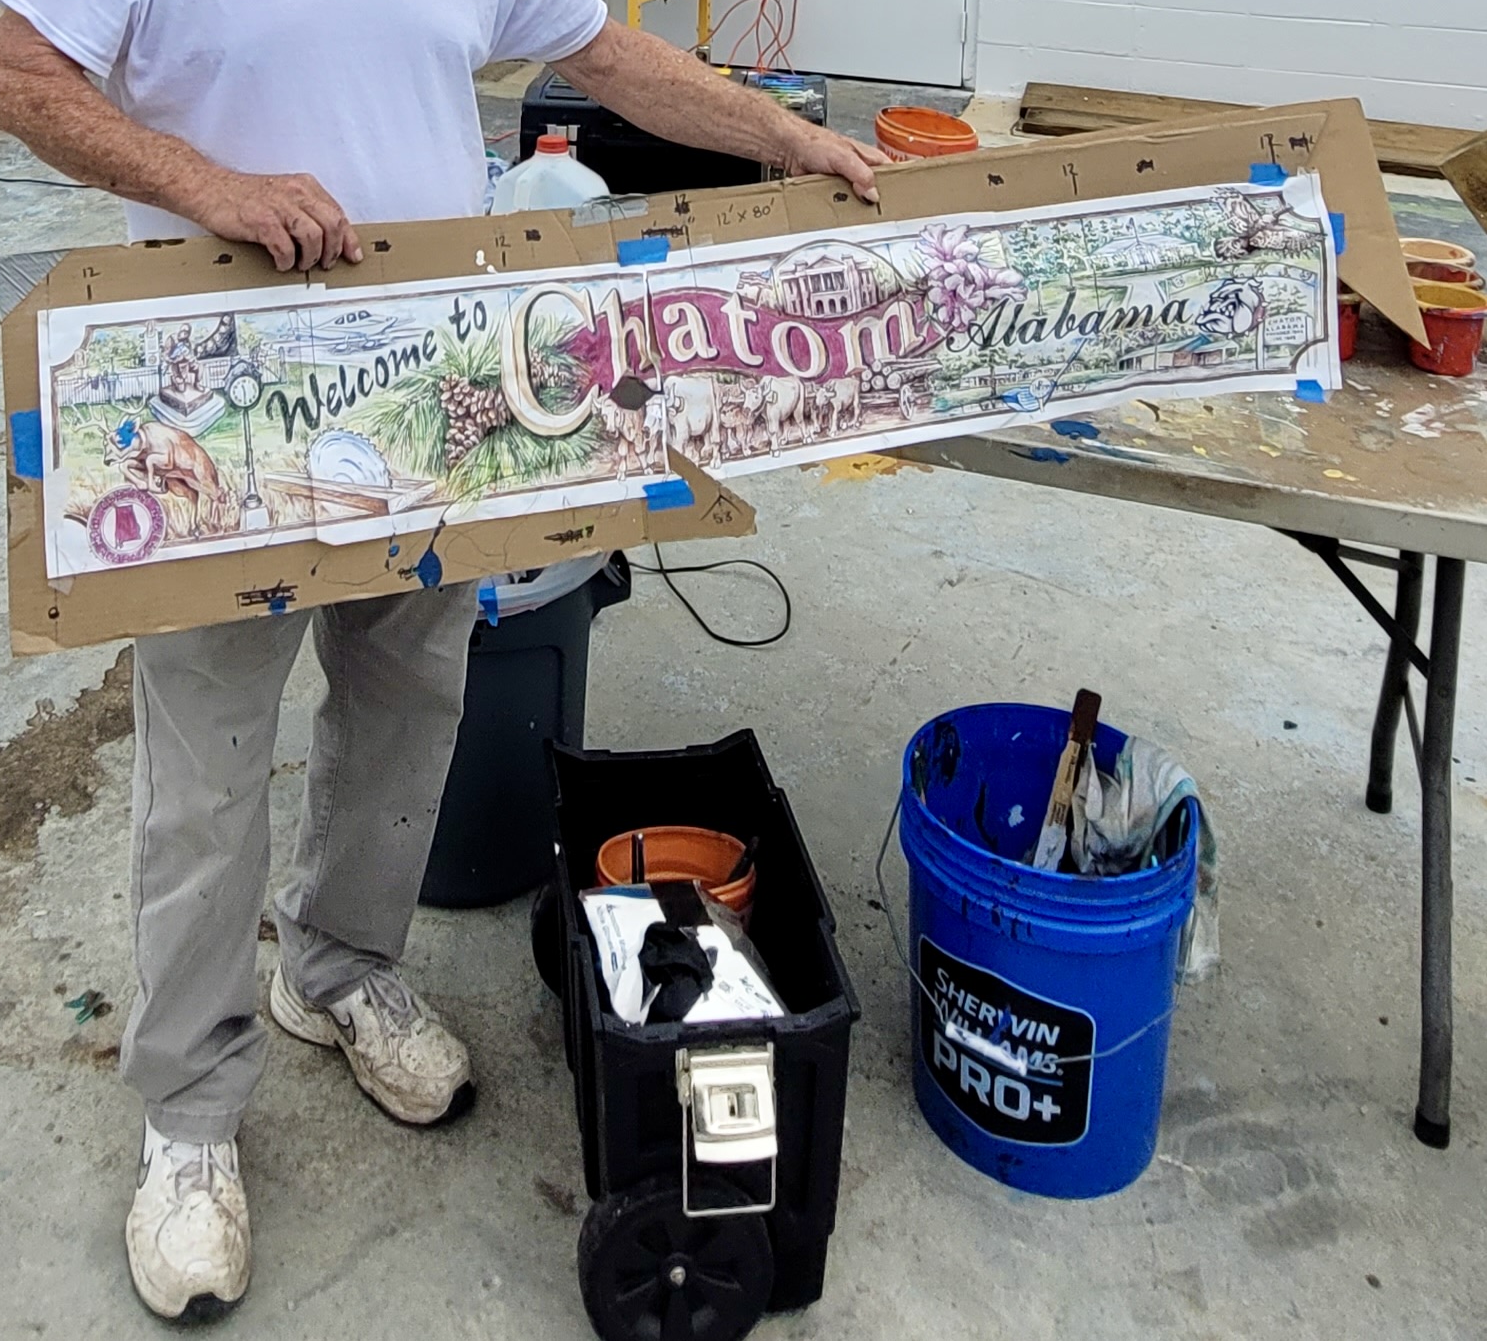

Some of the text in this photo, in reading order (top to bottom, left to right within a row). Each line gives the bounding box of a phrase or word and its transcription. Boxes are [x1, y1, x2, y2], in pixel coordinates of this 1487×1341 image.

[501, 282, 925, 437] Chatom
[946, 288, 1194, 352] Alabama
[265, 296, 487, 444] Welcome to
[934, 967, 1061, 1047] SHERWIN
[933, 1029, 1062, 1123] PRO+
